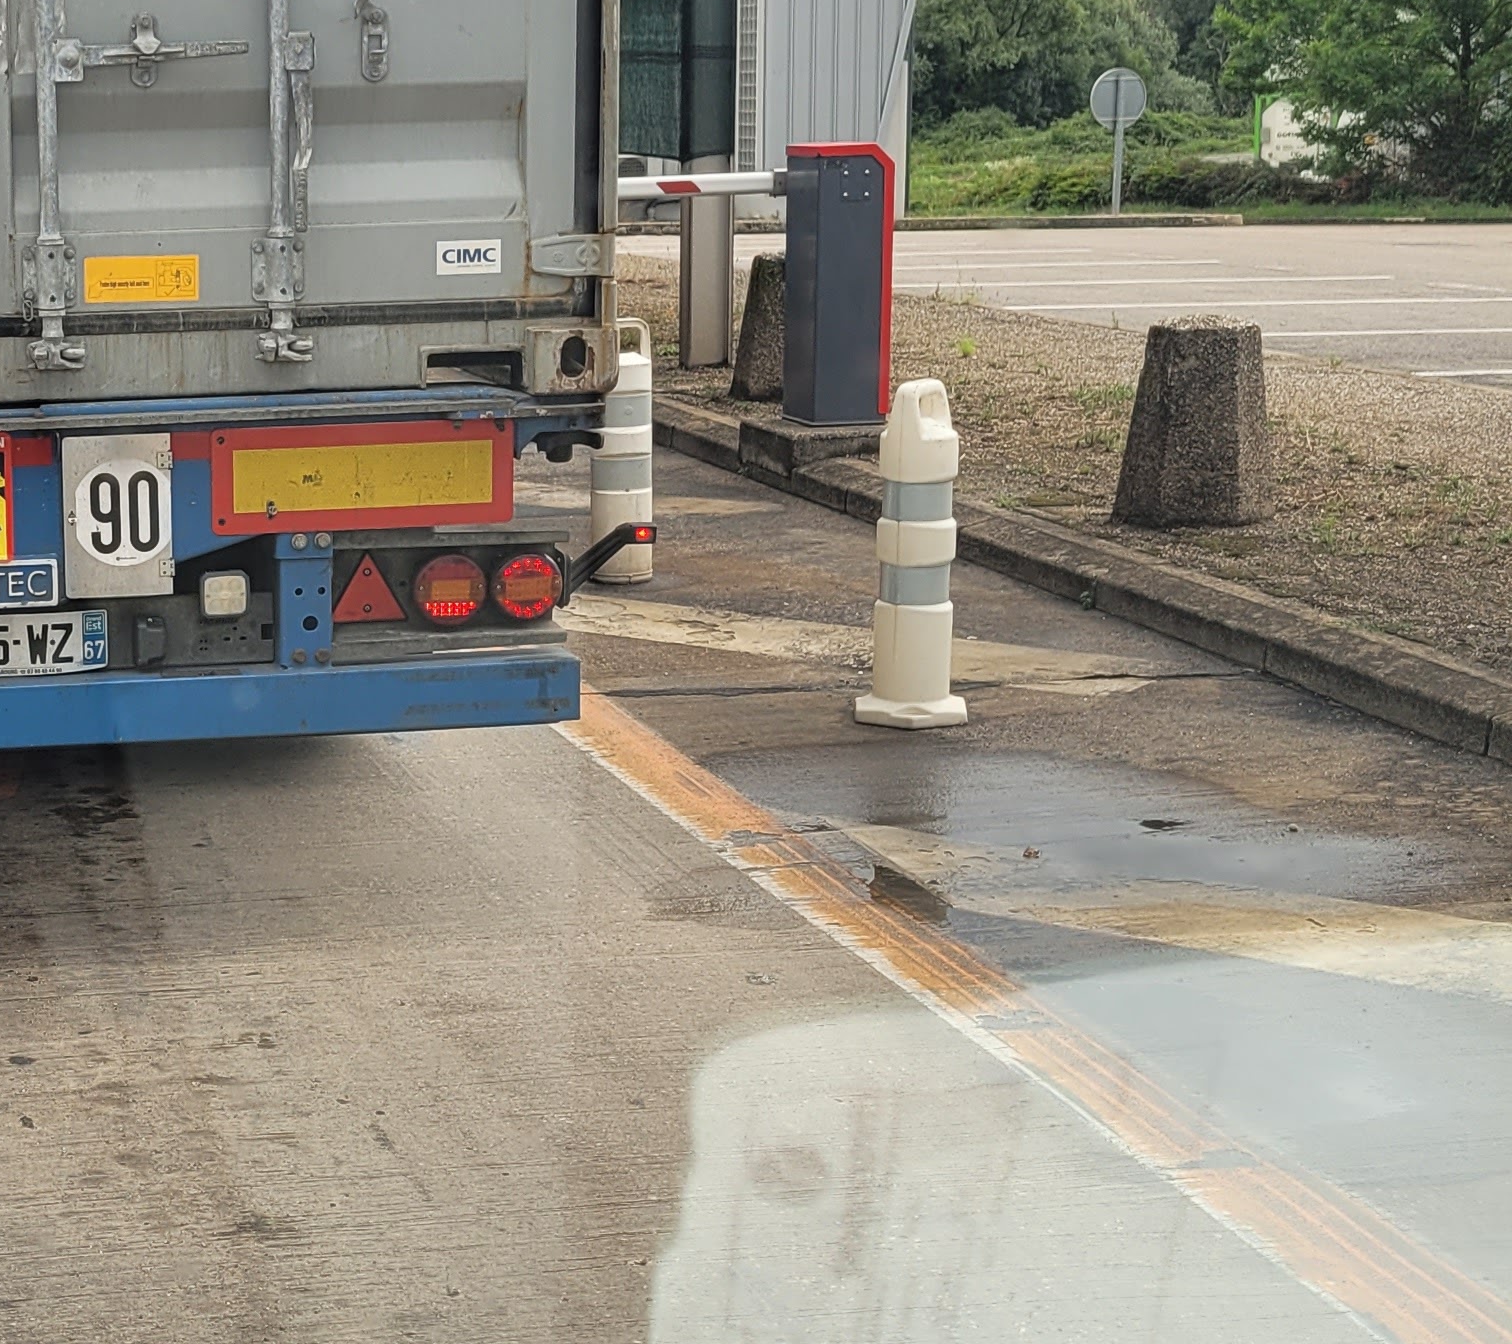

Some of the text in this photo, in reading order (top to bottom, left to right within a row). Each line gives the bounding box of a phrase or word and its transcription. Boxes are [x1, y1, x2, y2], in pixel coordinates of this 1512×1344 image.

[441, 247, 497, 264] CIMC
[89, 469, 161, 555] 90
[85, 621, 102, 631] Est
[84, 639, 105, 660] 67
